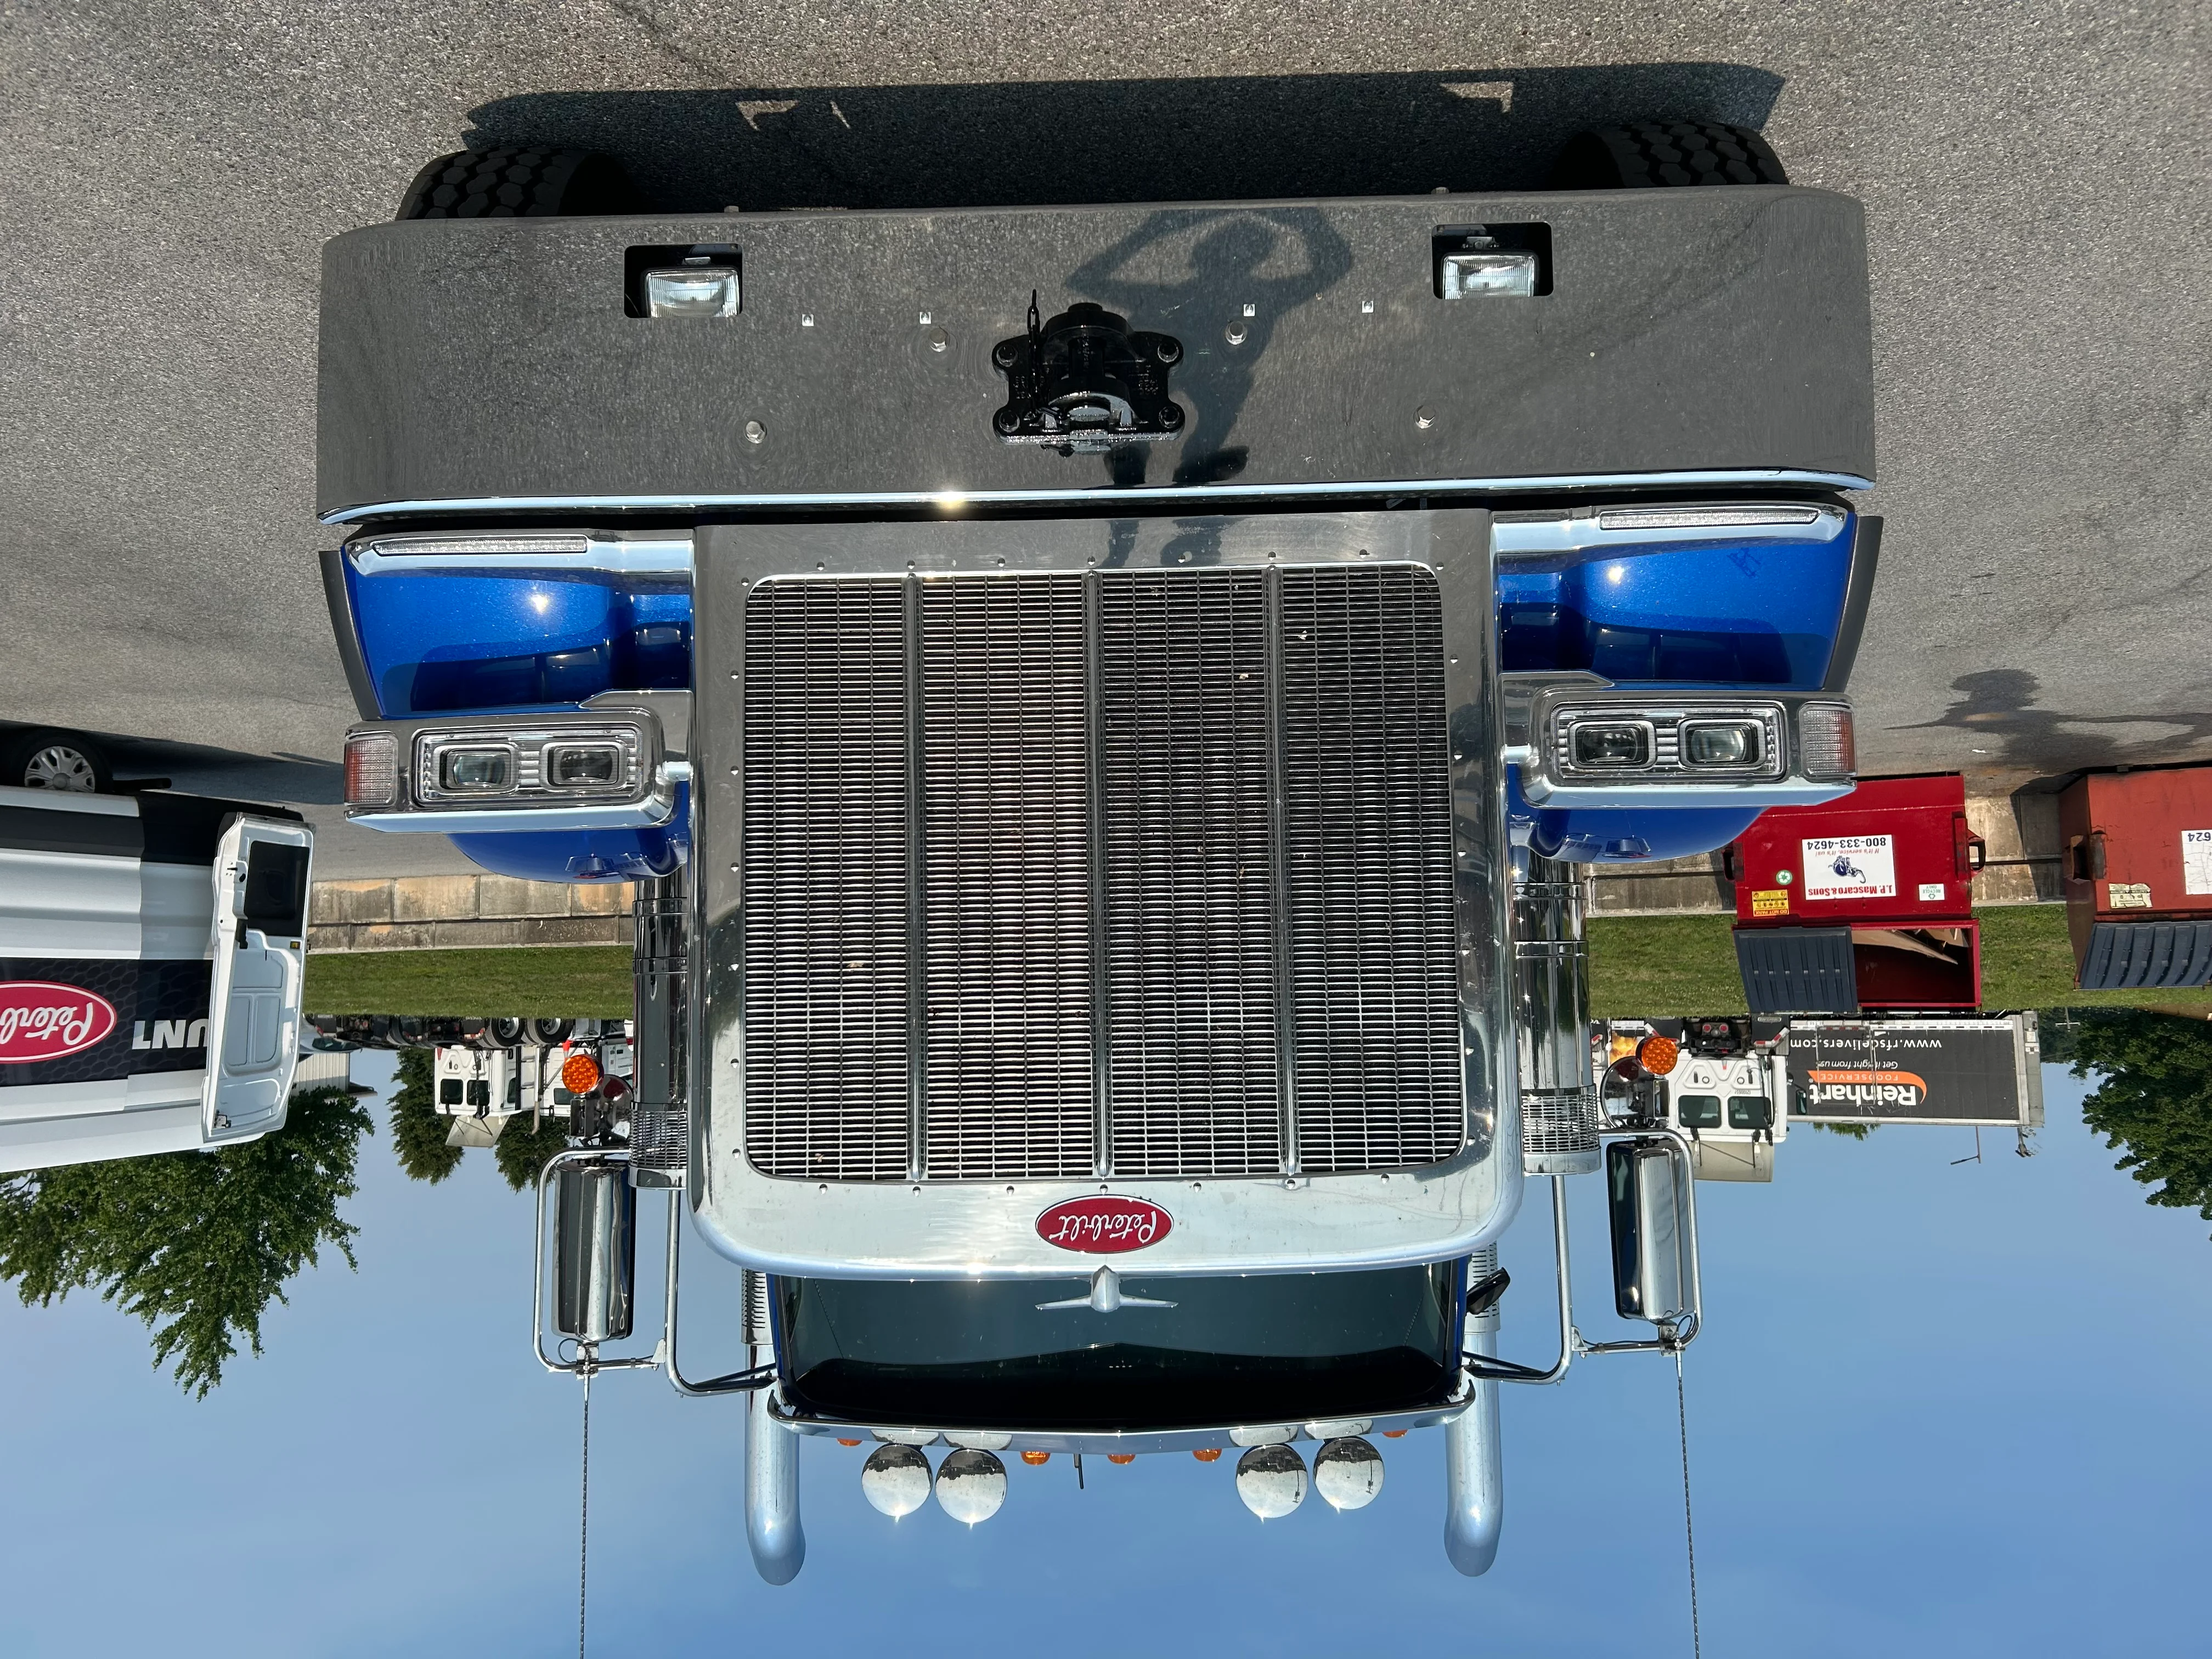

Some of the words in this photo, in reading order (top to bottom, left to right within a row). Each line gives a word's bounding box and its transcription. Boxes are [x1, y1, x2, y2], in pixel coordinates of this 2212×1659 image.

[1807, 837, 1886, 851] 800-333-4624
[1808, 888, 1830, 896] Sons
[1838, 885, 1877, 895] Mascaro
[1878, 885, 1892, 894] J.P.
[1790, 1039, 1942, 1051] www.rfsdelivers.com
[1831, 1060, 1852, 1070] from
[1853, 1059, 1873, 1070] ight
[1882, 1060, 1898, 1070] Get
[1809, 1084, 1916, 1107] Reinhart
[1048, 1210, 1156, 1244] Peterbilt
